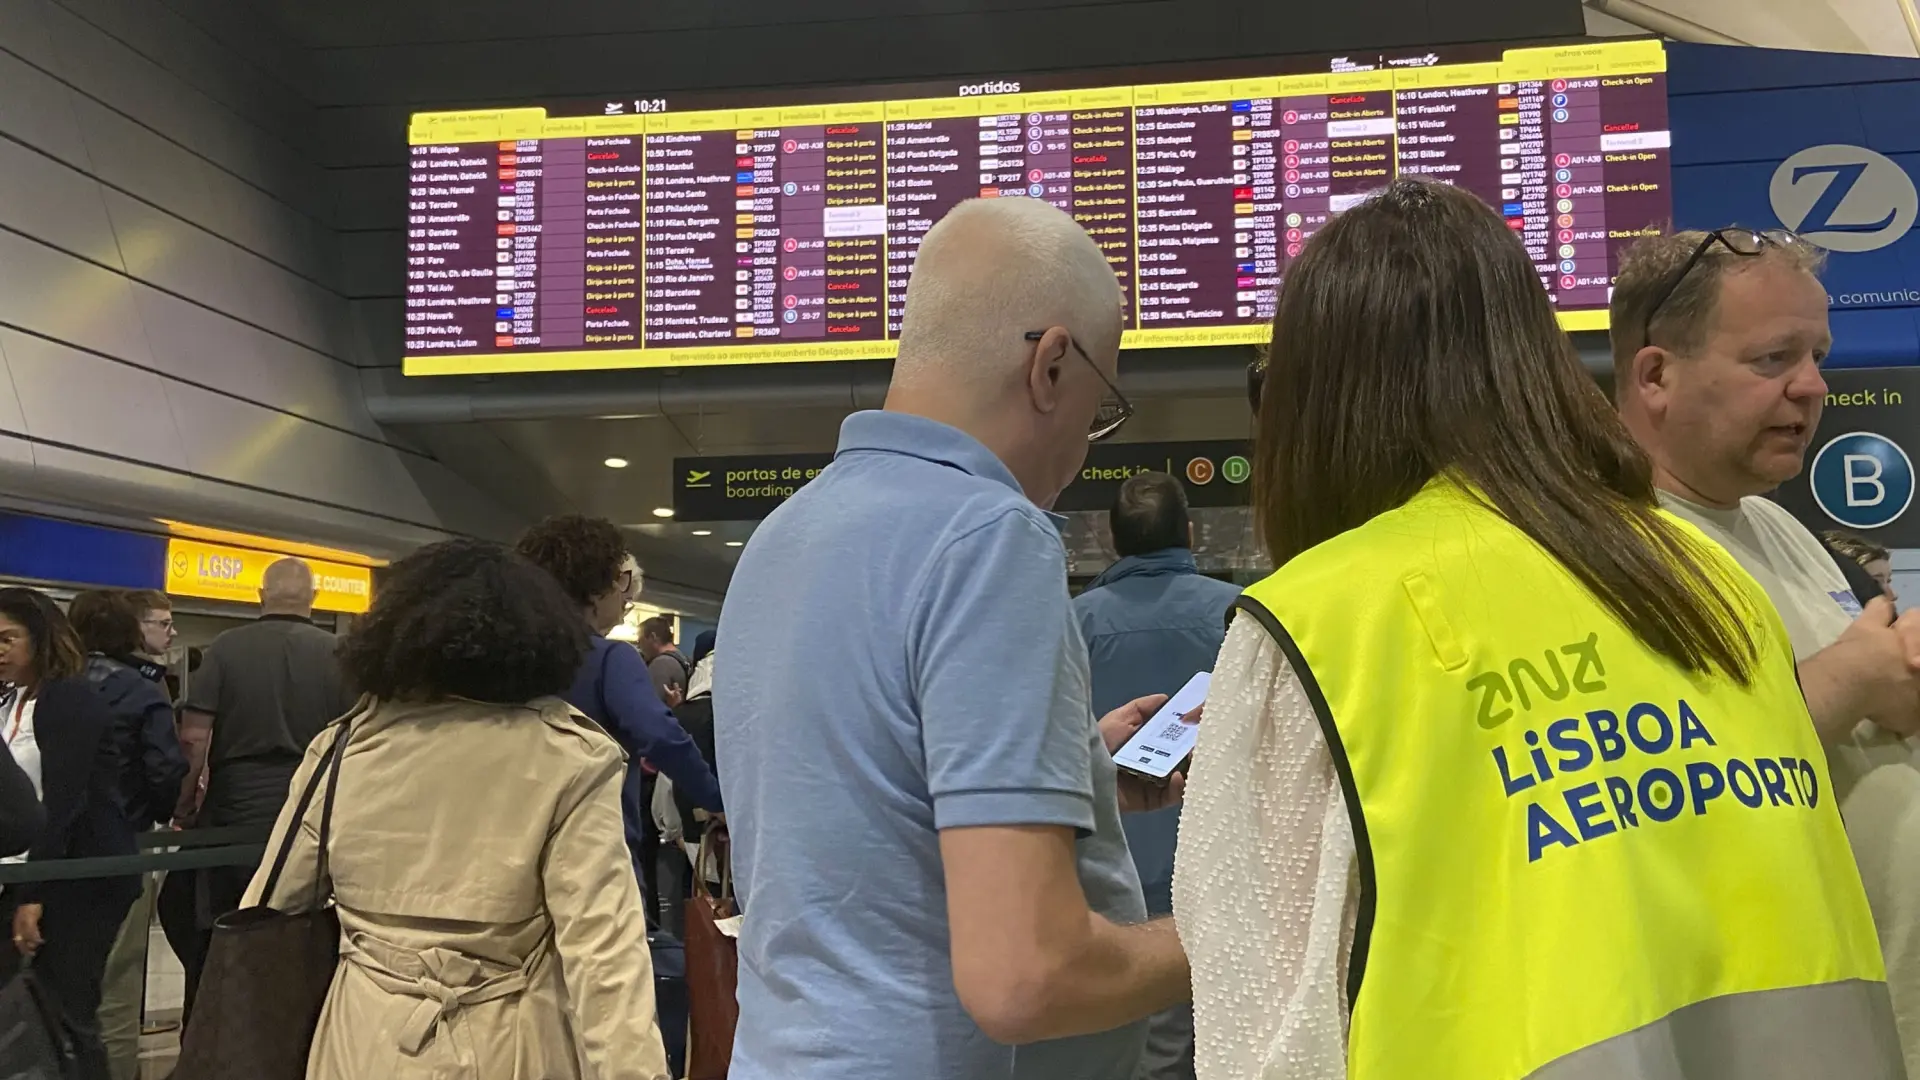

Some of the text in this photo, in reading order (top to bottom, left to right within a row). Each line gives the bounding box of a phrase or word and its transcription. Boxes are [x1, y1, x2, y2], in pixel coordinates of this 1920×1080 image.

[959, 80, 1020, 96] partidas
[1568, 80, 1597, 88] A01-A30
[1395, 91, 1416, 100] 16:10
[634, 99, 666, 113] 10:21
[1396, 106, 1416, 114] 16:15
[1397, 120, 1417, 129] 16:15
[1603, 123, 1638, 131] Cancelled
[1398, 136, 1418, 144] 16:20
[1399, 150, 1418, 159] 16:20
[1571, 155, 1601, 163] A01-A30
[1637, 152, 1656, 160] Open
[1400, 165, 1419, 174] 16:30
[1572, 185, 1602, 193] A01-A30
[1639, 183, 1658, 191] Open
[1883, 388, 1902, 405] in
[1082, 466, 1132, 480] check
[1194, 463, 1206, 478] C
[1231, 462, 1243, 477] D
[726, 468, 777, 484] portas
[782, 467, 800, 479] de
[1843, 454, 1886, 507] B
[726, 484, 794, 498] boarding
[198, 552, 243, 579] LGSP
[1526, 758, 1819, 864] AEROPORTO
